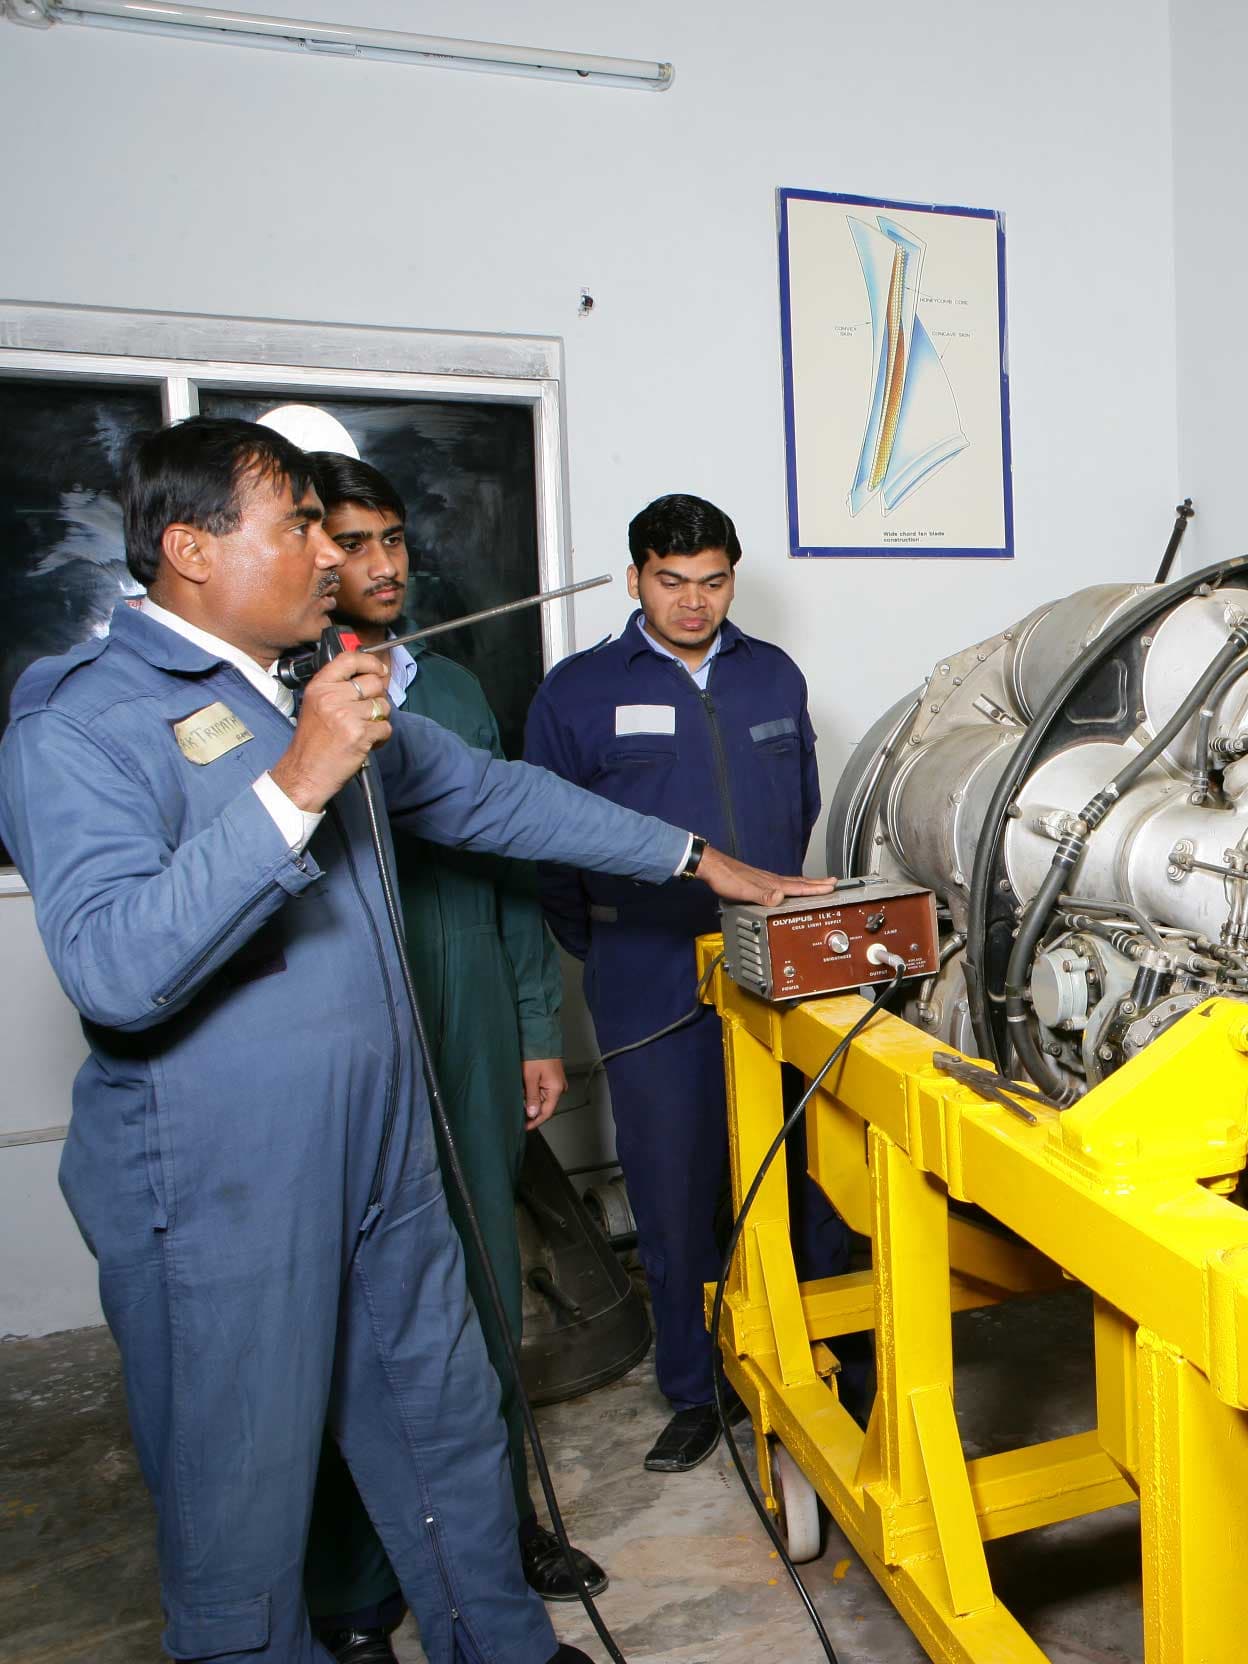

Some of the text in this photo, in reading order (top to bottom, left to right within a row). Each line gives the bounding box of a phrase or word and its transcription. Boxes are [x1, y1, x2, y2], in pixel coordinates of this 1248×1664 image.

[772, 914, 813, 927] OLYMPUS
[807, 921, 822, 929] LIGHT
[869, 969, 888, 977] OUTPUT
